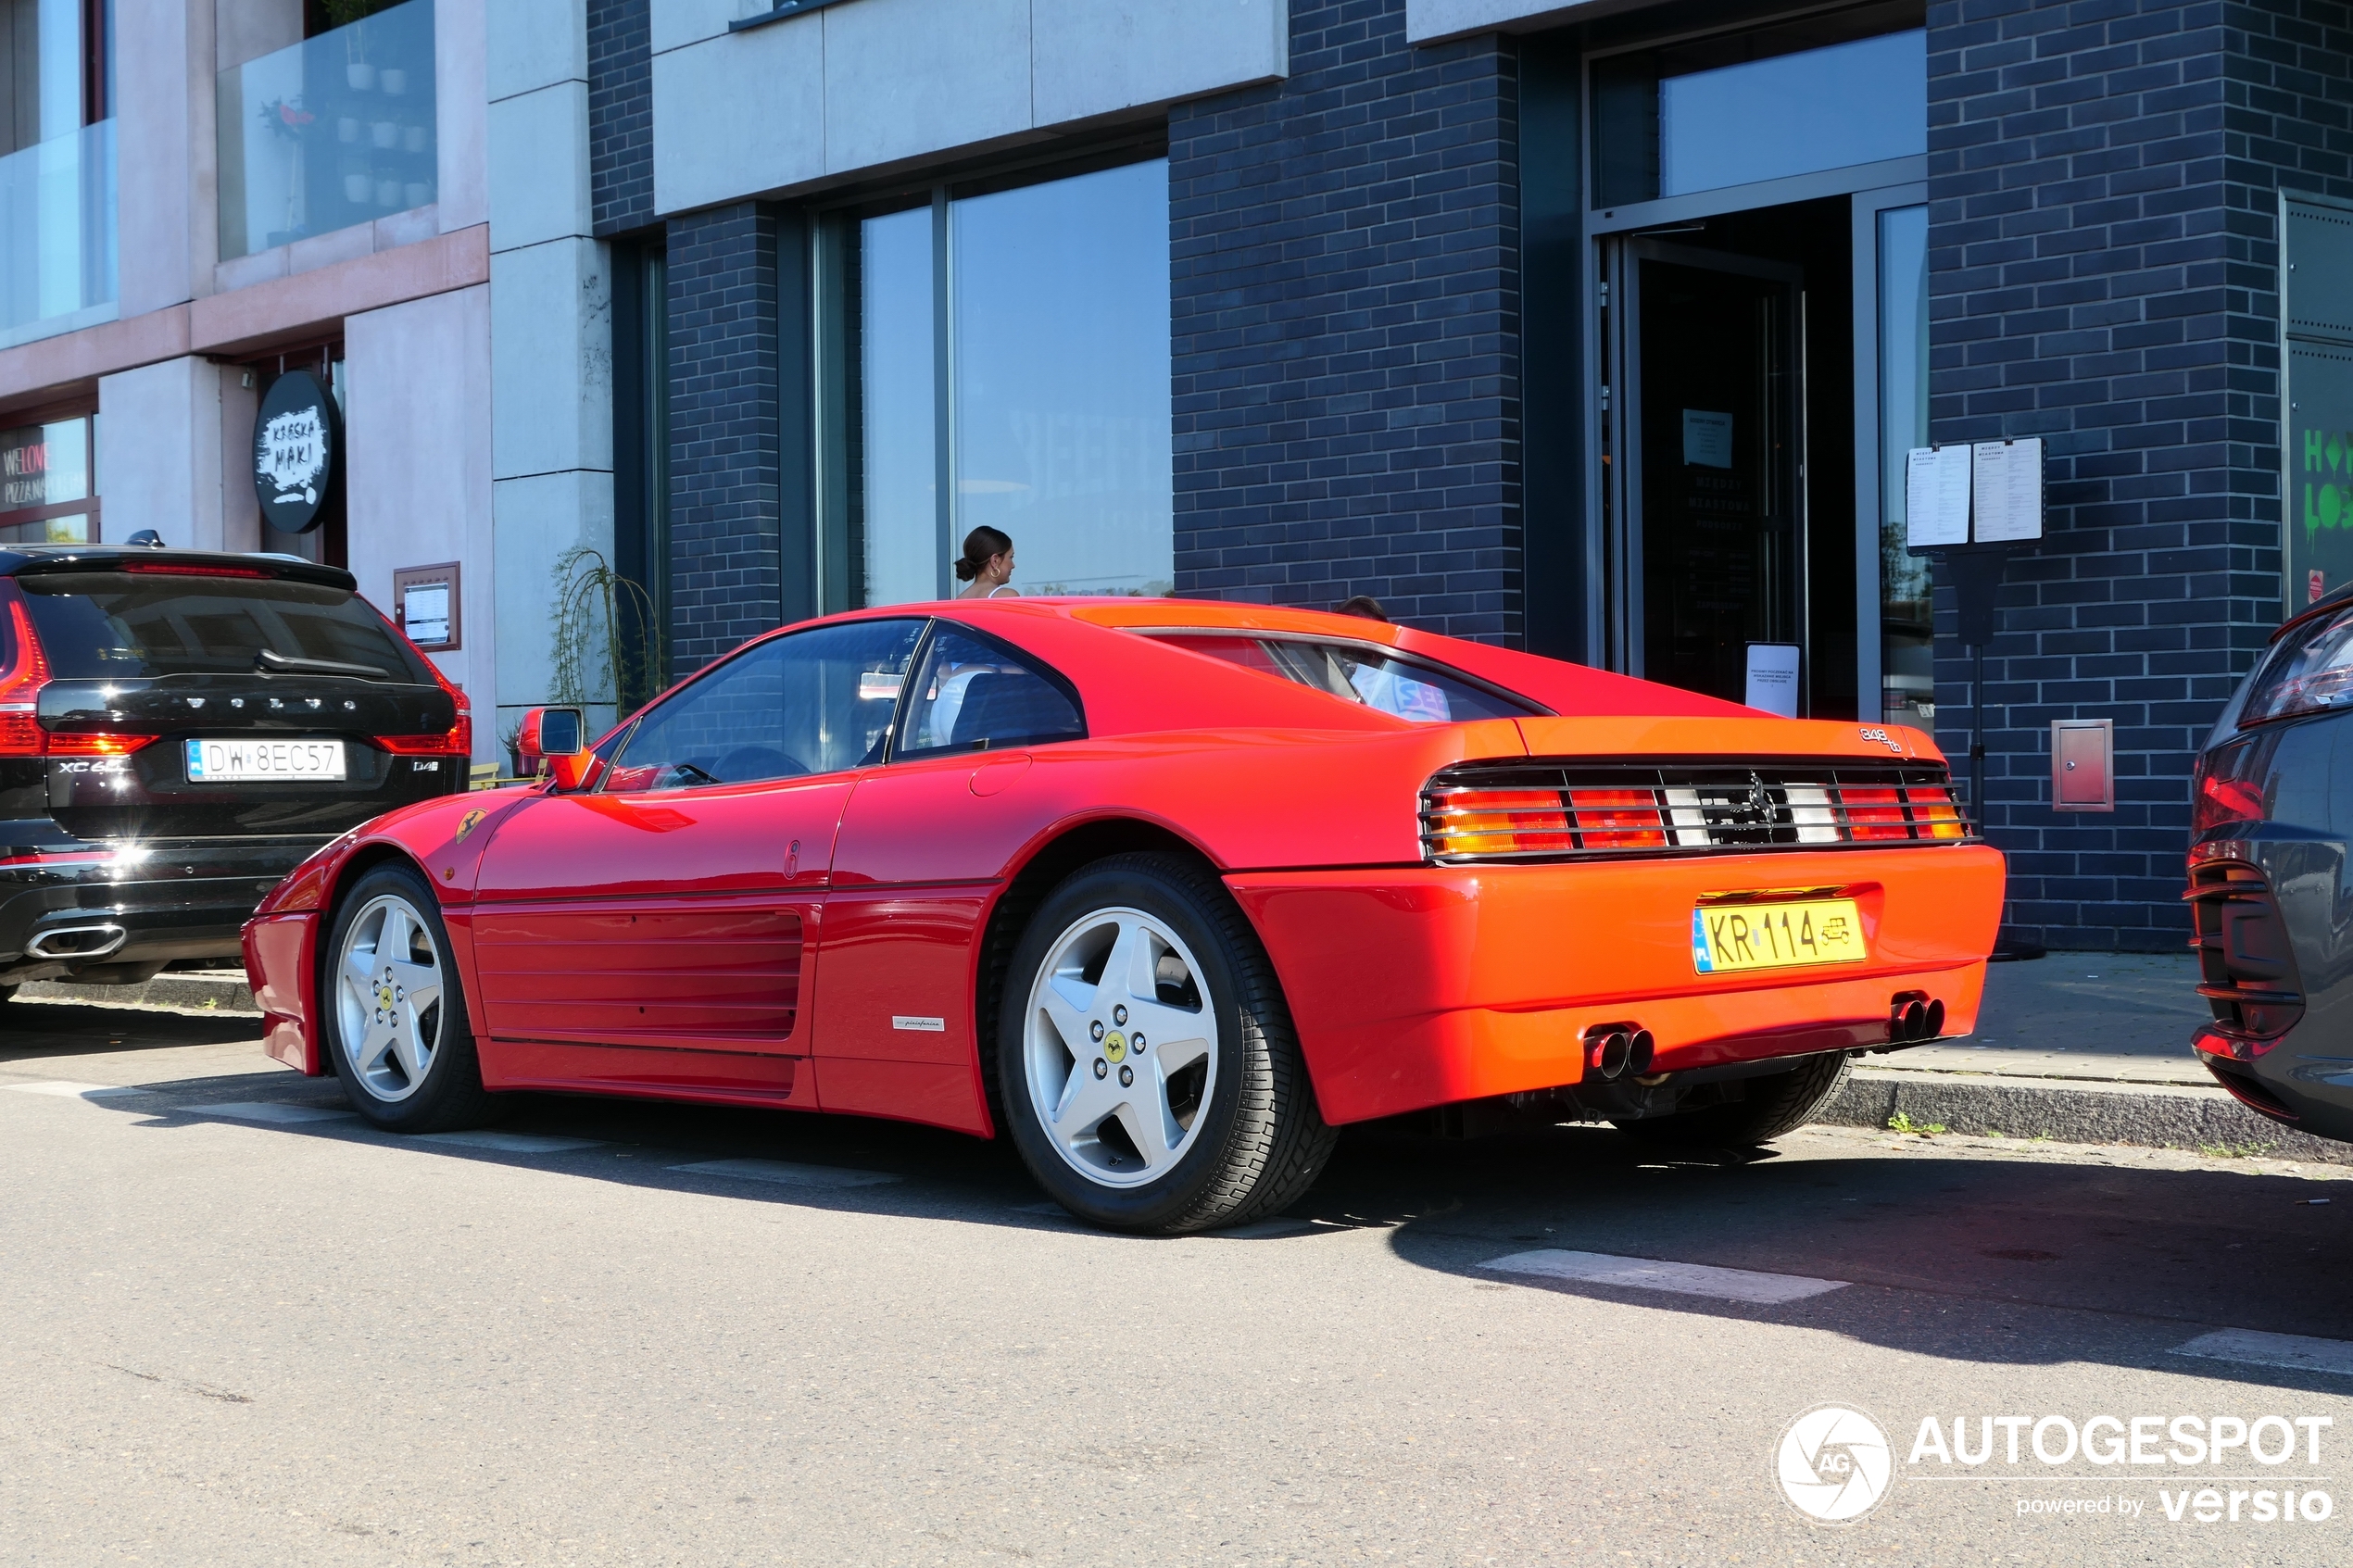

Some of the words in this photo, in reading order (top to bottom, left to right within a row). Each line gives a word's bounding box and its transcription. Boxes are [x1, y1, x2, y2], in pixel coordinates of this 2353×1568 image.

[273, 420, 315, 441] KRESKA
[3, 447, 24, 477] WE
[21, 442, 53, 473] LOVE
[275, 443, 313, 471] MAKI
[5, 480, 34, 504] PIZZA
[1688, 496, 1751, 511] MIASTOWA
[186, 696, 357, 710] VOLVO
[1858, 728, 1888, 742] 348
[209, 745, 243, 771] DW
[257, 745, 334, 771] 8EC57
[1695, 947, 1710, 962] PL
[1710, 914, 1755, 963] KR
[1764, 910, 1818, 959] 114
